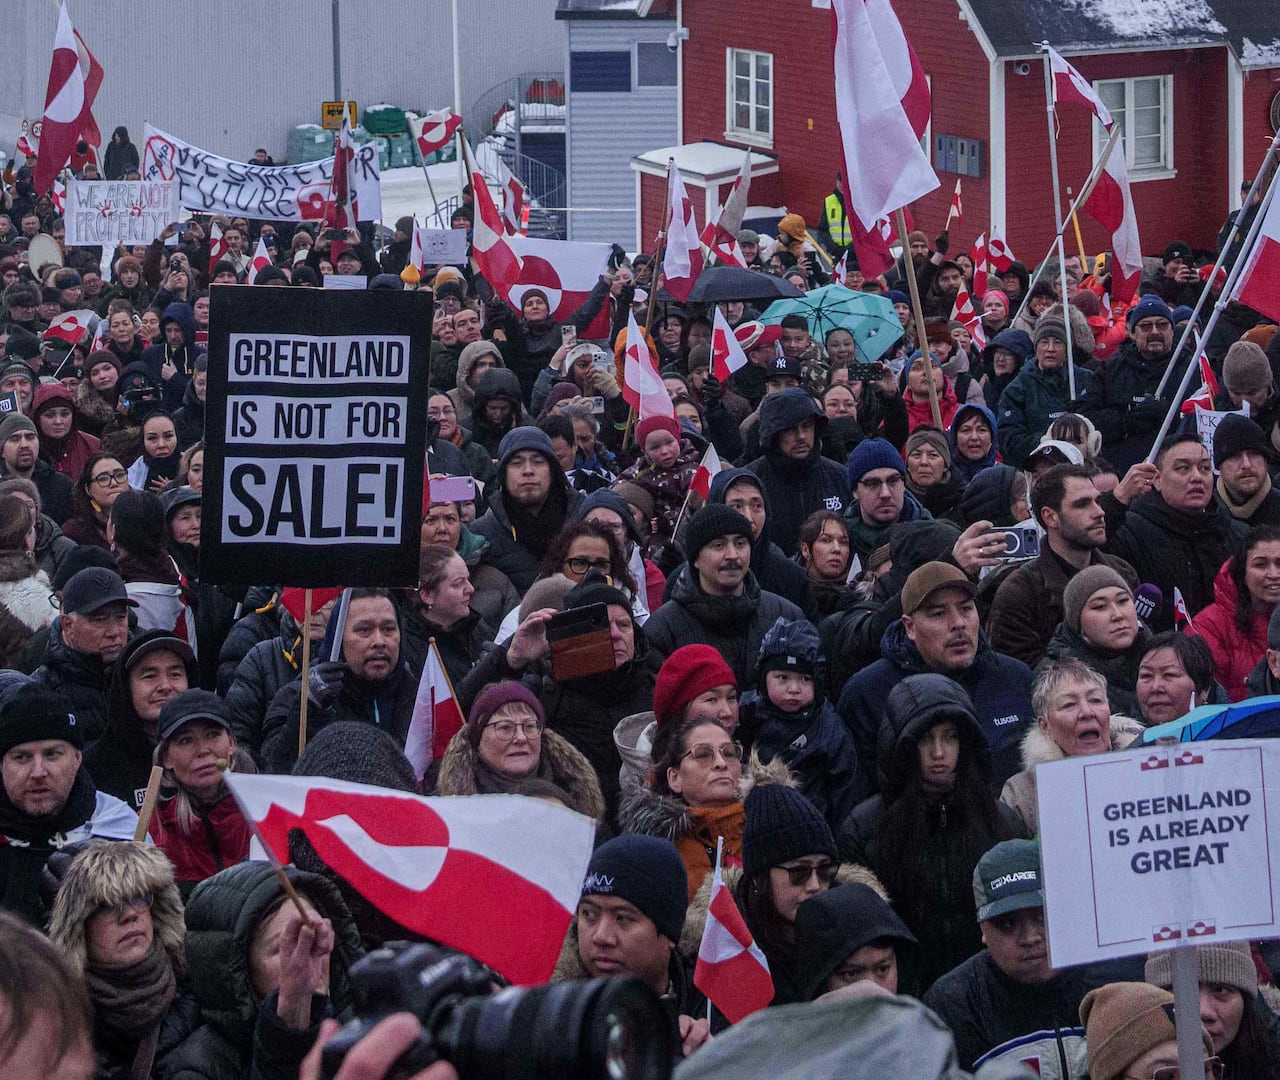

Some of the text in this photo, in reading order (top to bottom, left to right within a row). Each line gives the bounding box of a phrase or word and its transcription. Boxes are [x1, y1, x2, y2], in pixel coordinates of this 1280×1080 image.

[176, 145, 380, 186] WE SHAPE OR
[75, 183, 172, 209] WE ARE NOT
[175, 167, 297, 217] FUTURE
[234, 339, 404, 378] GREENLAND
[231, 400, 401, 439] IS NOT FOR
[228, 463, 399, 538] SALE!
[1137, 594, 1156, 608] RADIO
[1103, 789, 1251, 821] GREENLAND
[1109, 814, 1250, 847] IS ALREADY
[1130, 841, 1229, 874] GREAT
